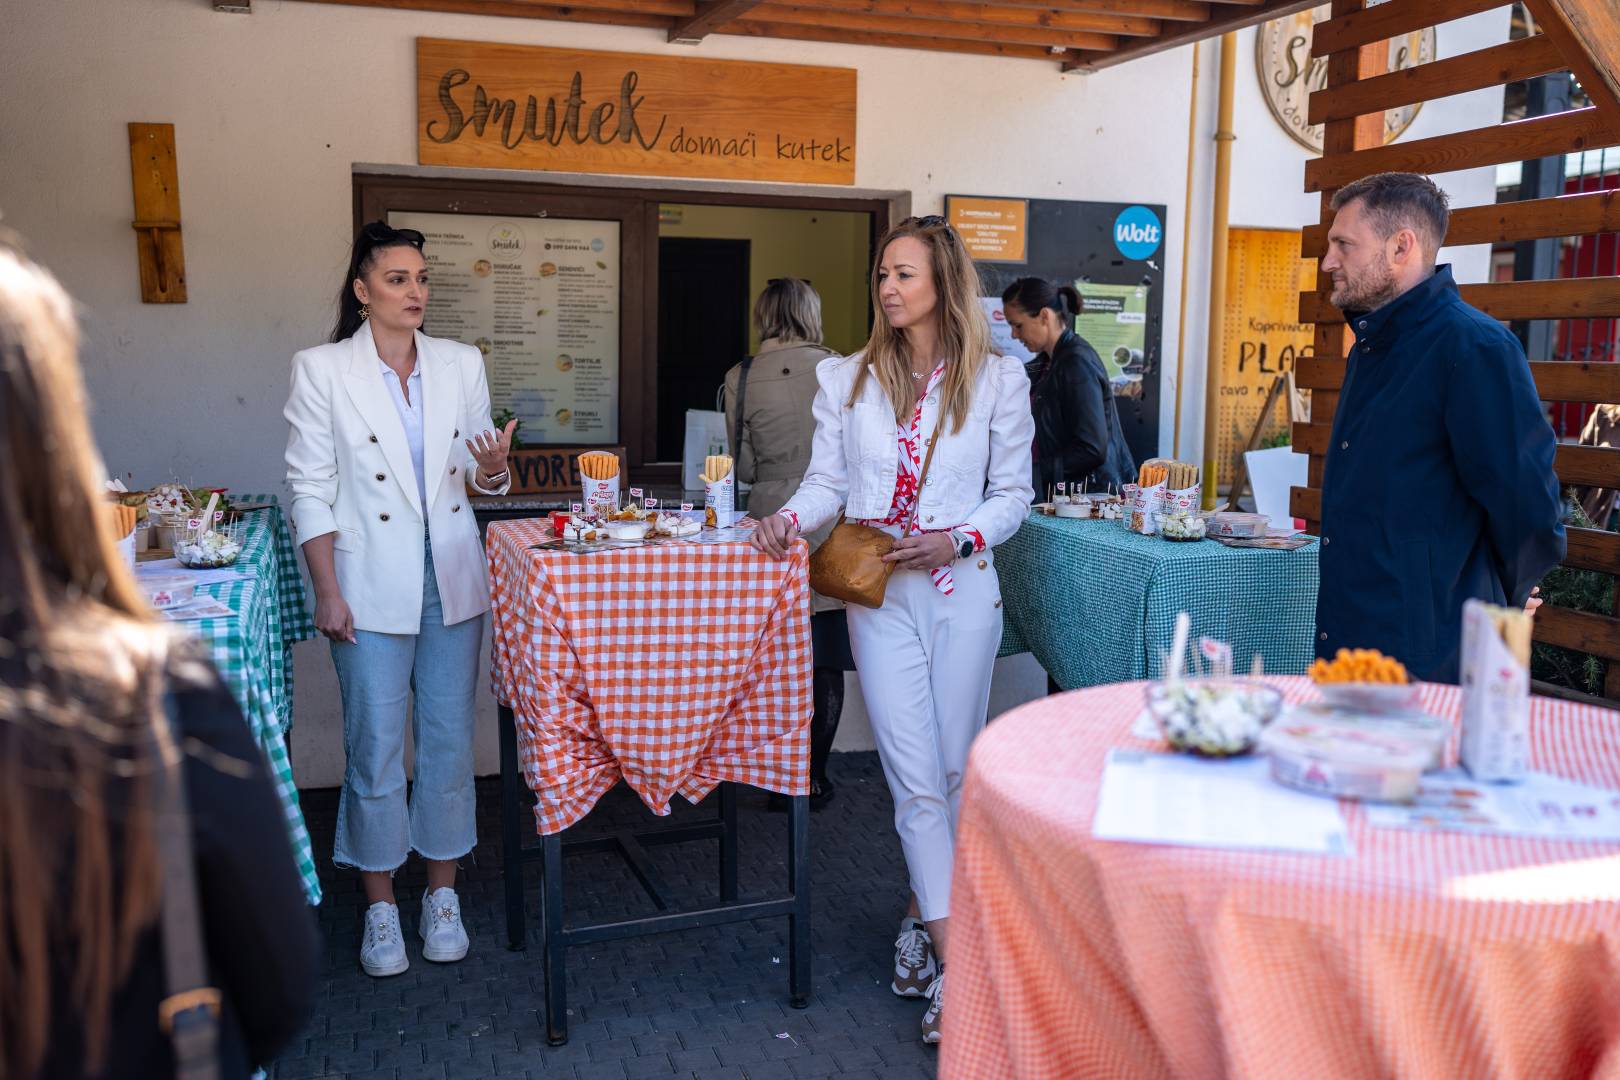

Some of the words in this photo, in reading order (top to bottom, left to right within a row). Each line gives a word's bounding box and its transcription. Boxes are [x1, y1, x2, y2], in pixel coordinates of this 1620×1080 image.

[426, 68, 667, 151] Smutek
[776, 133, 851, 164] kutek
[1116, 223, 1160, 243] Wolt
